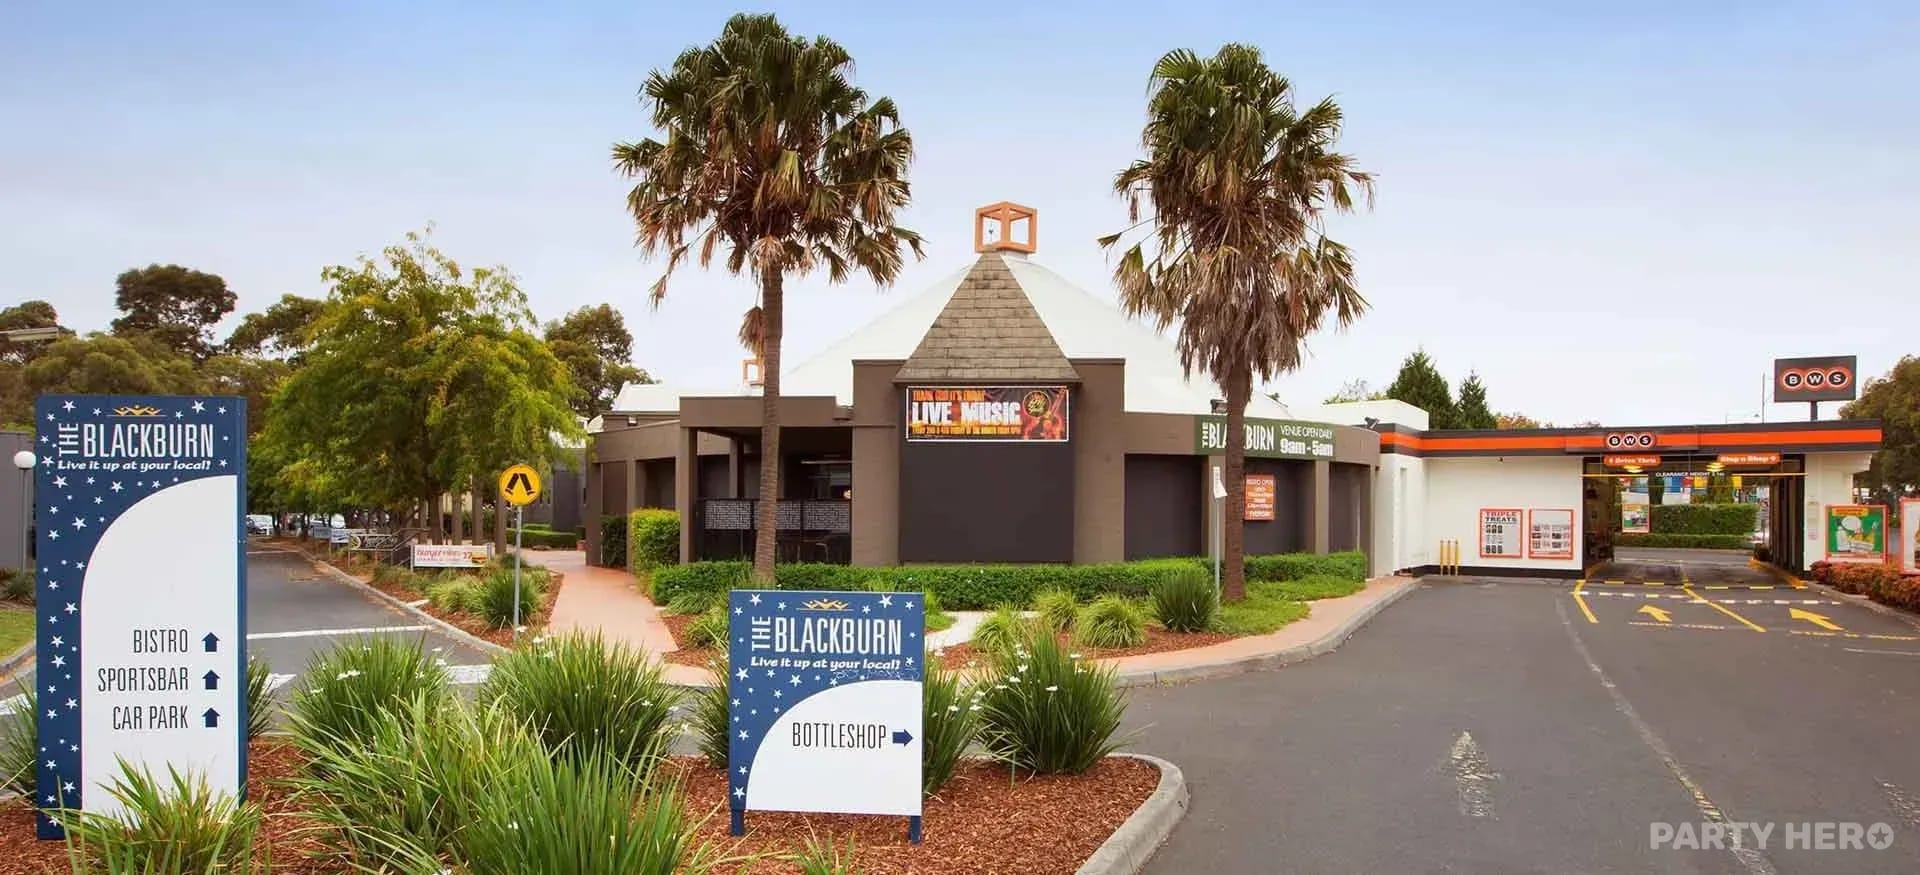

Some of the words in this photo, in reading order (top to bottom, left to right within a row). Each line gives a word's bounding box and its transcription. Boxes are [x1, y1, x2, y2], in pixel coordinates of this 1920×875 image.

[1786, 371, 1844, 387] BWS
[912, 401, 952, 425] LIVE
[960, 401, 1021, 425] MUSIC
[57, 423, 79, 457] THE
[83, 423, 214, 459] BLACKBURN
[1280, 425, 1302, 437] VENUE
[1302, 427, 1319, 438] OPEN
[1609, 435, 1651, 446] BWS
[57, 460, 87, 470] Live
[89, 460, 100, 470] it
[102, 461, 120, 472] up
[122, 460, 138, 470] at
[140, 462, 171, 473] your
[133, 628, 188, 653] BISTRO
[751, 616, 771, 652] THE
[775, 616, 902, 656] BLACKBURN
[750, 656, 778, 667] Live
[780, 657, 791, 667] it
[793, 660, 811, 670] up
[812, 659, 828, 669] at
[830, 661, 860, 671] your
[97, 667, 189, 692] SPORTSBAR
[112, 706, 143, 730] CAR
[149, 705, 189, 729] PARK
[792, 722, 887, 749] BOTTLESHOP
